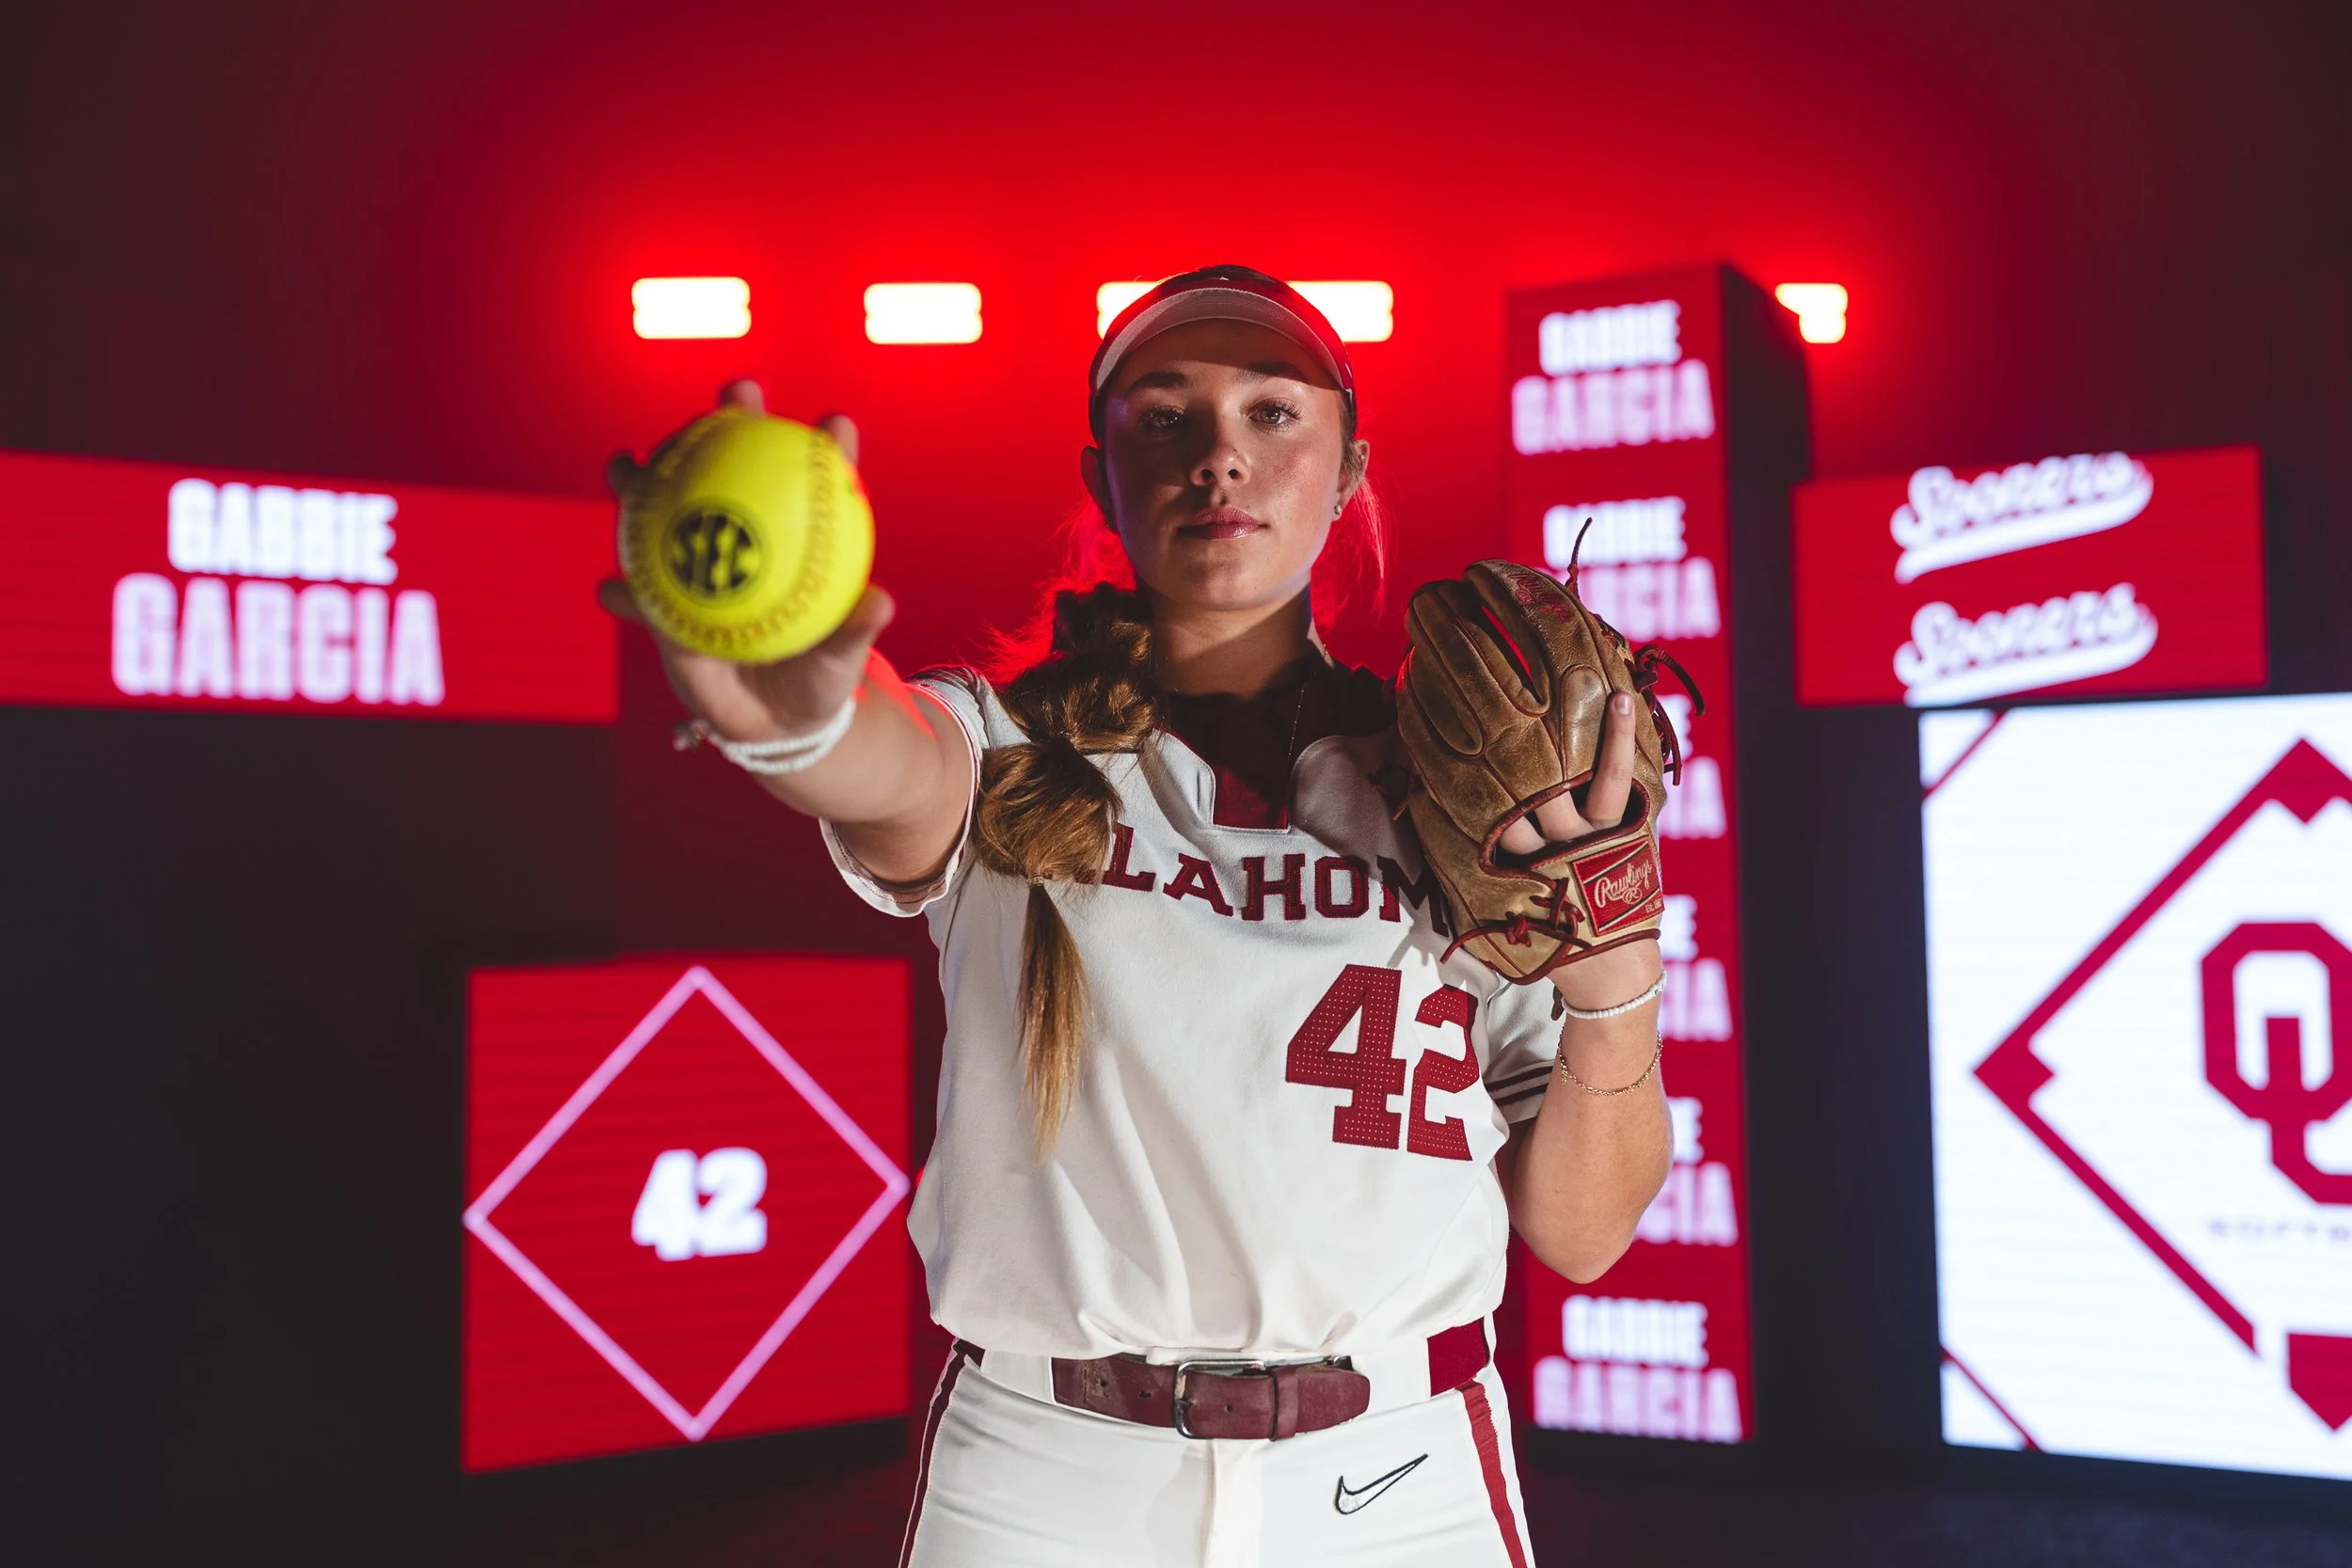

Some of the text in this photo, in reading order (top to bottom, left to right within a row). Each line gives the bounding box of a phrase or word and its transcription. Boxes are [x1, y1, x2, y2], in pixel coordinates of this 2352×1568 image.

[112, 572, 446, 705] GARCIA
[1076, 821, 1450, 938] LAHOM
[1594, 860, 1652, 909] Rawlings
[1285, 963, 1480, 1161] 42
[631, 1147, 769, 1262] 42
